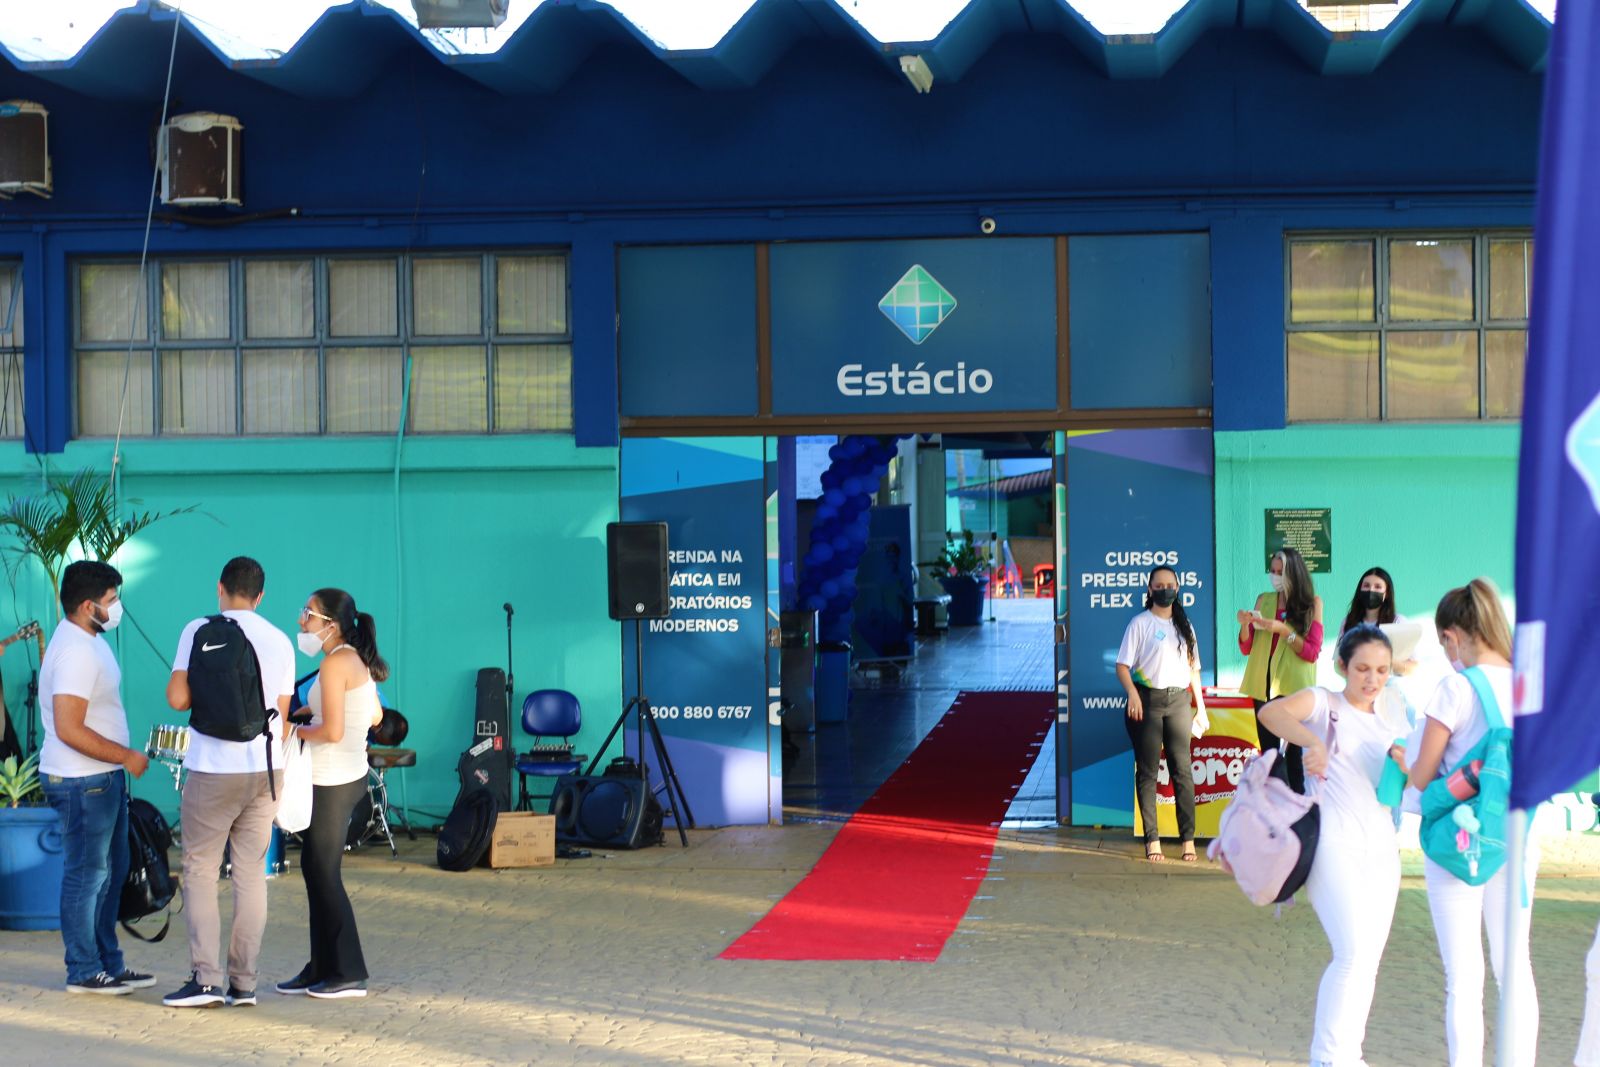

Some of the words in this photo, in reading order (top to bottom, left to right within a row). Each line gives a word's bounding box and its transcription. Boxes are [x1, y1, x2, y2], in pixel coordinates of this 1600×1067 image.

[837, 362, 993, 396] Estácio
[669, 550, 716, 563] RENDA
[721, 550, 743, 563] NA
[1105, 550, 1179, 567] CURSOS
[669, 570, 714, 587] ÁTICA
[717, 572, 741, 586] EM
[1090, 593, 1133, 608] FLEX
[649, 618, 739, 633] MODERNOS
[642, 705, 680, 719] 800
[683, 705, 714, 719] 880
[717, 705, 752, 719] 6767
